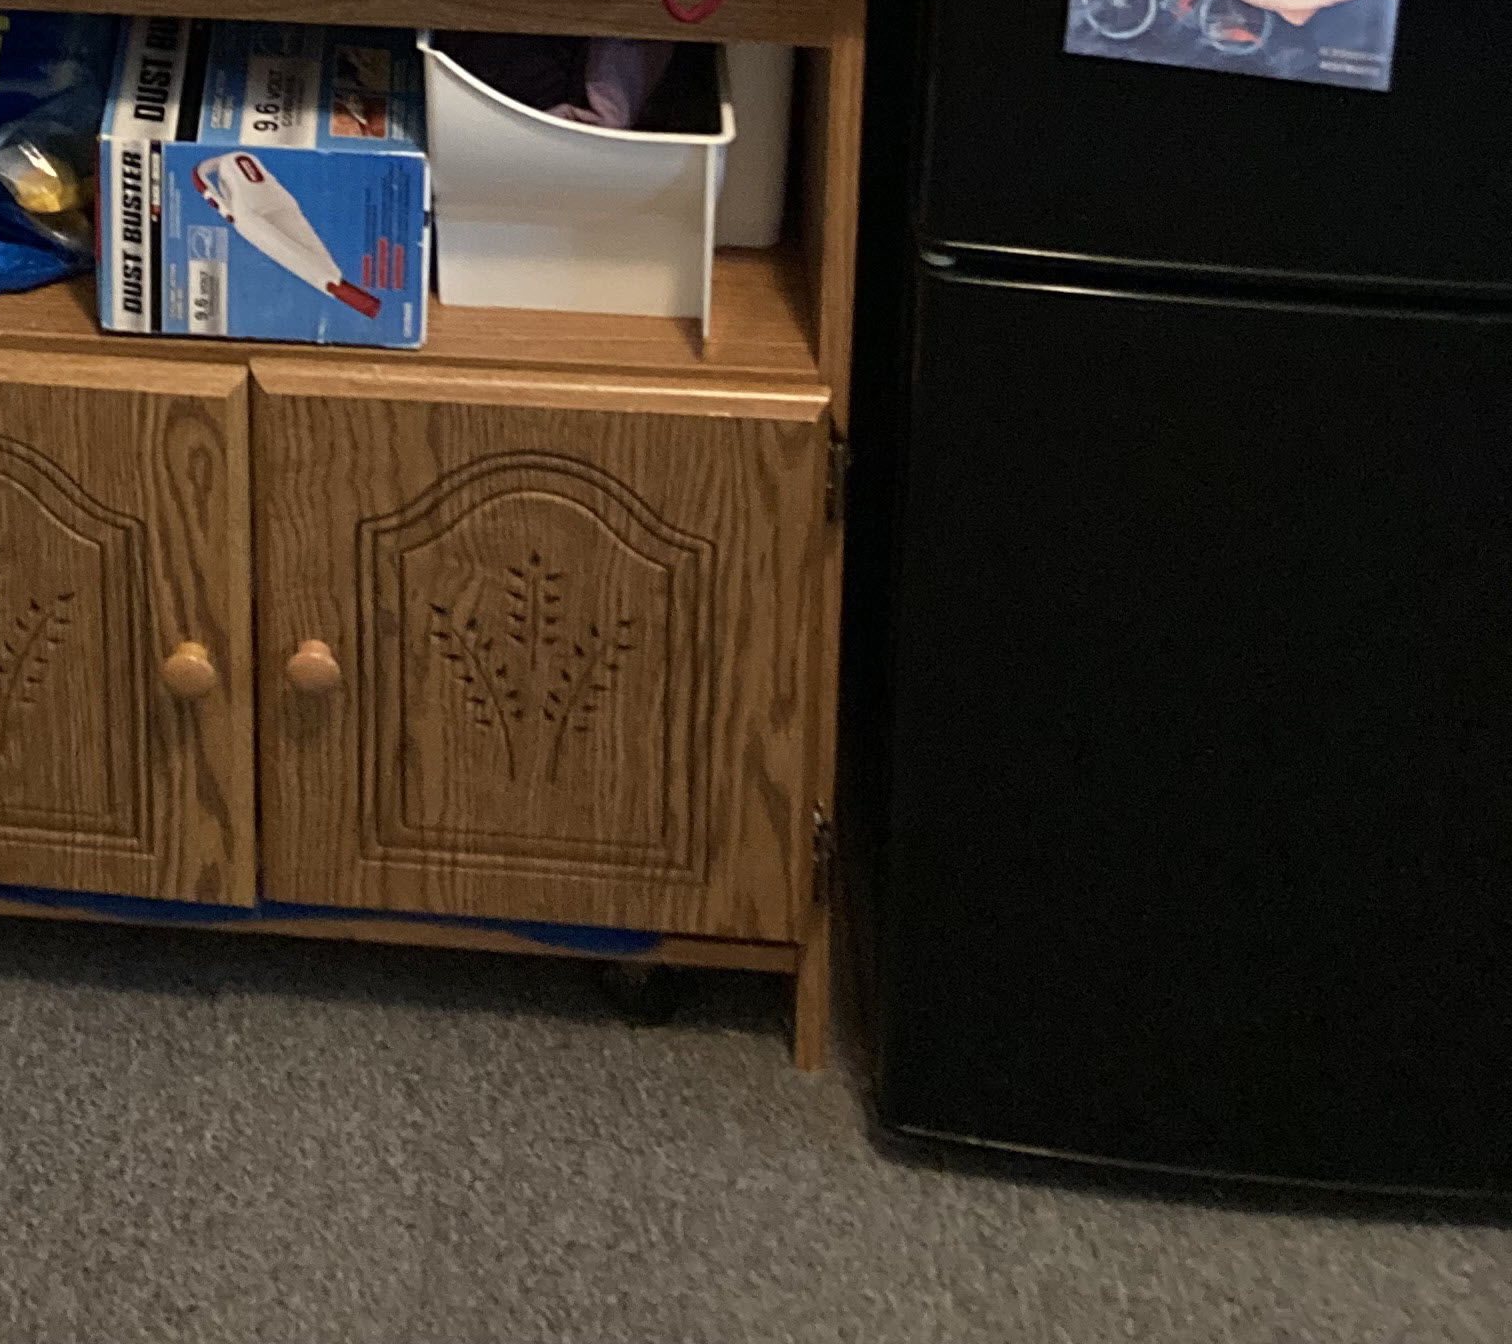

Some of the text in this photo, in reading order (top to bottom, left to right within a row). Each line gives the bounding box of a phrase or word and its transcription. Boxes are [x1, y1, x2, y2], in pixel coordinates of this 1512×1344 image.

[134, 55, 173, 123] DUST
[253, 102, 280, 132] 9.6
[121, 150, 143, 315] DUST BUSTER
